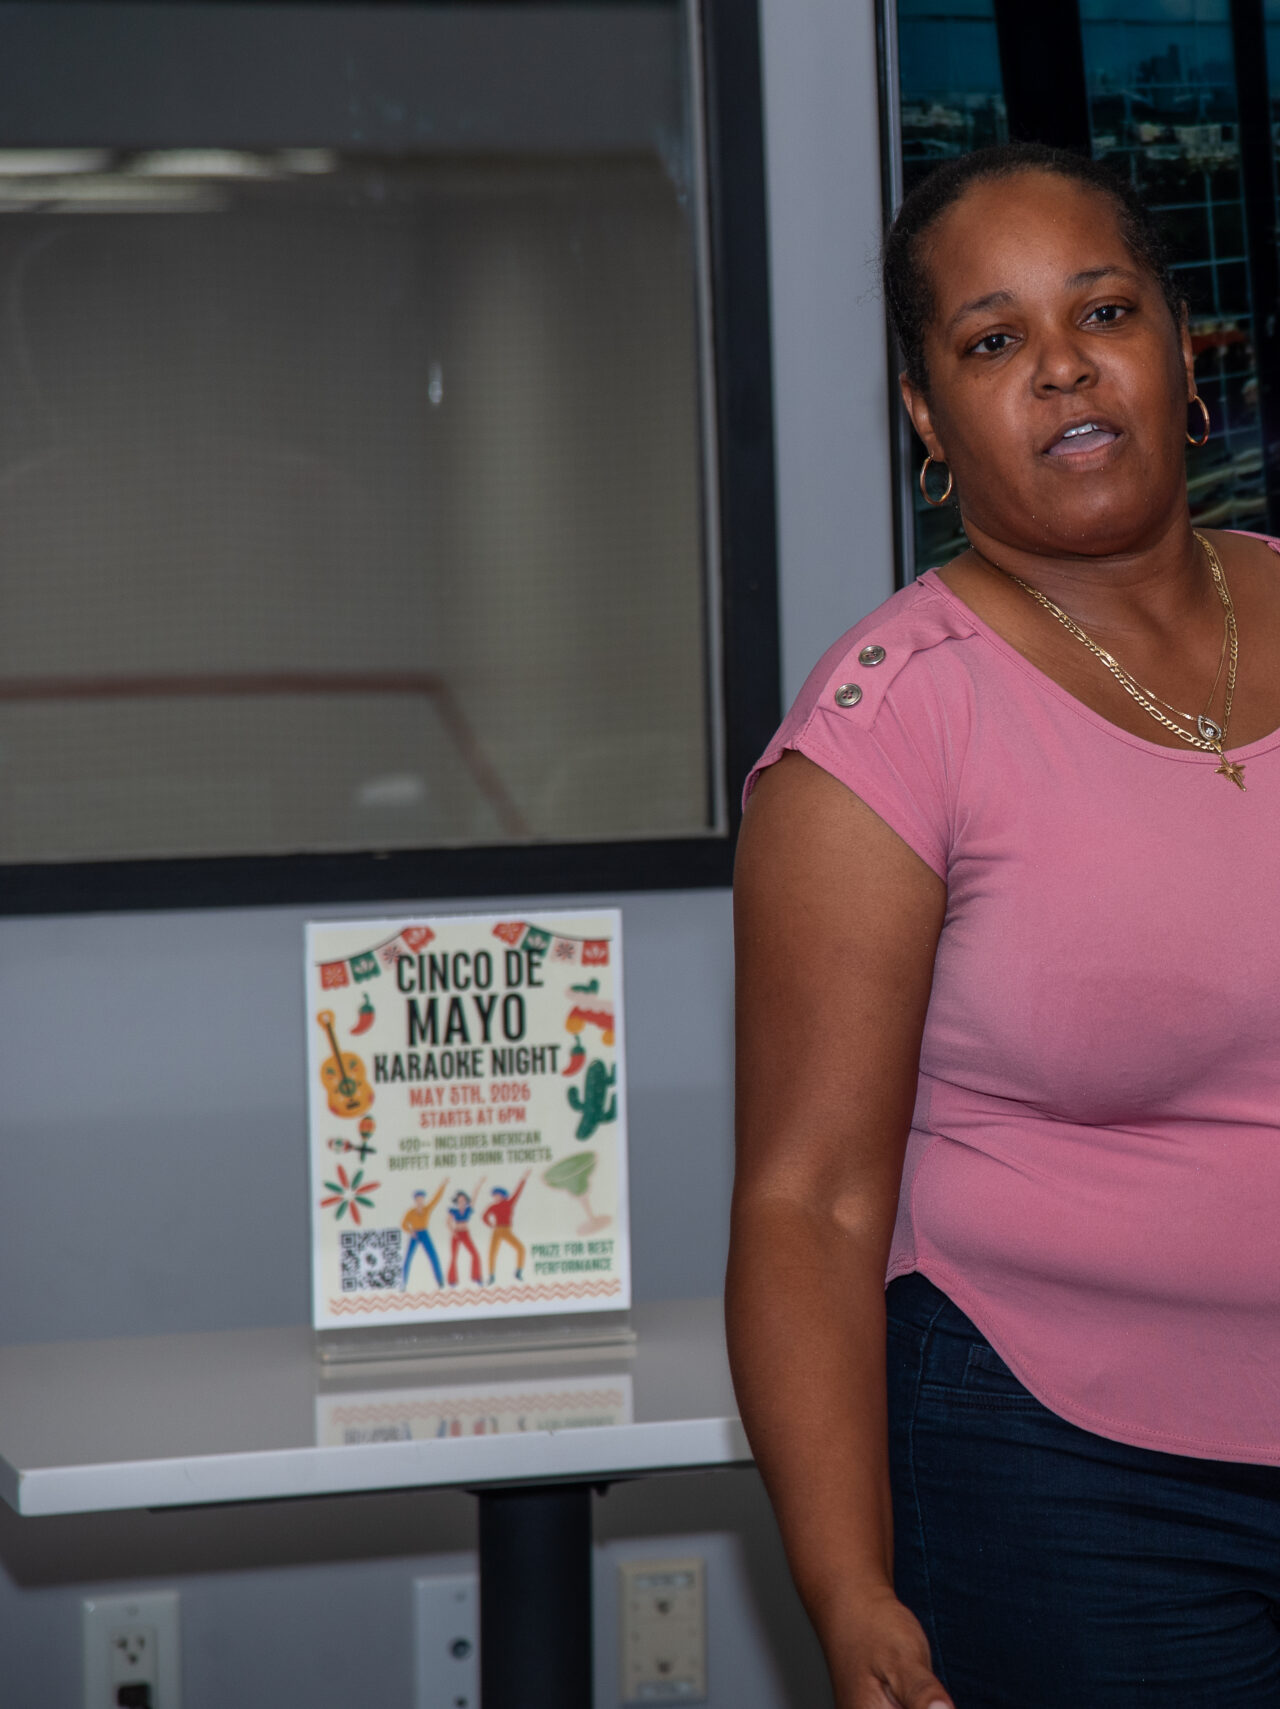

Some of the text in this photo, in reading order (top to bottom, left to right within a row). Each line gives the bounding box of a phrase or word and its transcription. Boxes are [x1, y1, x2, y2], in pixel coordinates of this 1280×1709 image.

[397, 949, 543, 994] CINCO DE
[407, 993, 526, 1047] MAYO
[374, 1045, 561, 1083] KARAOKE NIGHT
[409, 1087, 445, 1107] MAY
[490, 1082, 531, 1103] 2026
[420, 1107, 526, 1128] STARTS AT 6PM
[434, 1133, 488, 1150] INCLUDES
[492, 1130, 541, 1147] MEXICAN
[388, 1147, 553, 1171] BUFFET AND 2 DRINK TICKETS
[532, 1240, 614, 1258] PRIZE FOR BEST
[535, 1258, 612, 1275] PERFORMANCE
